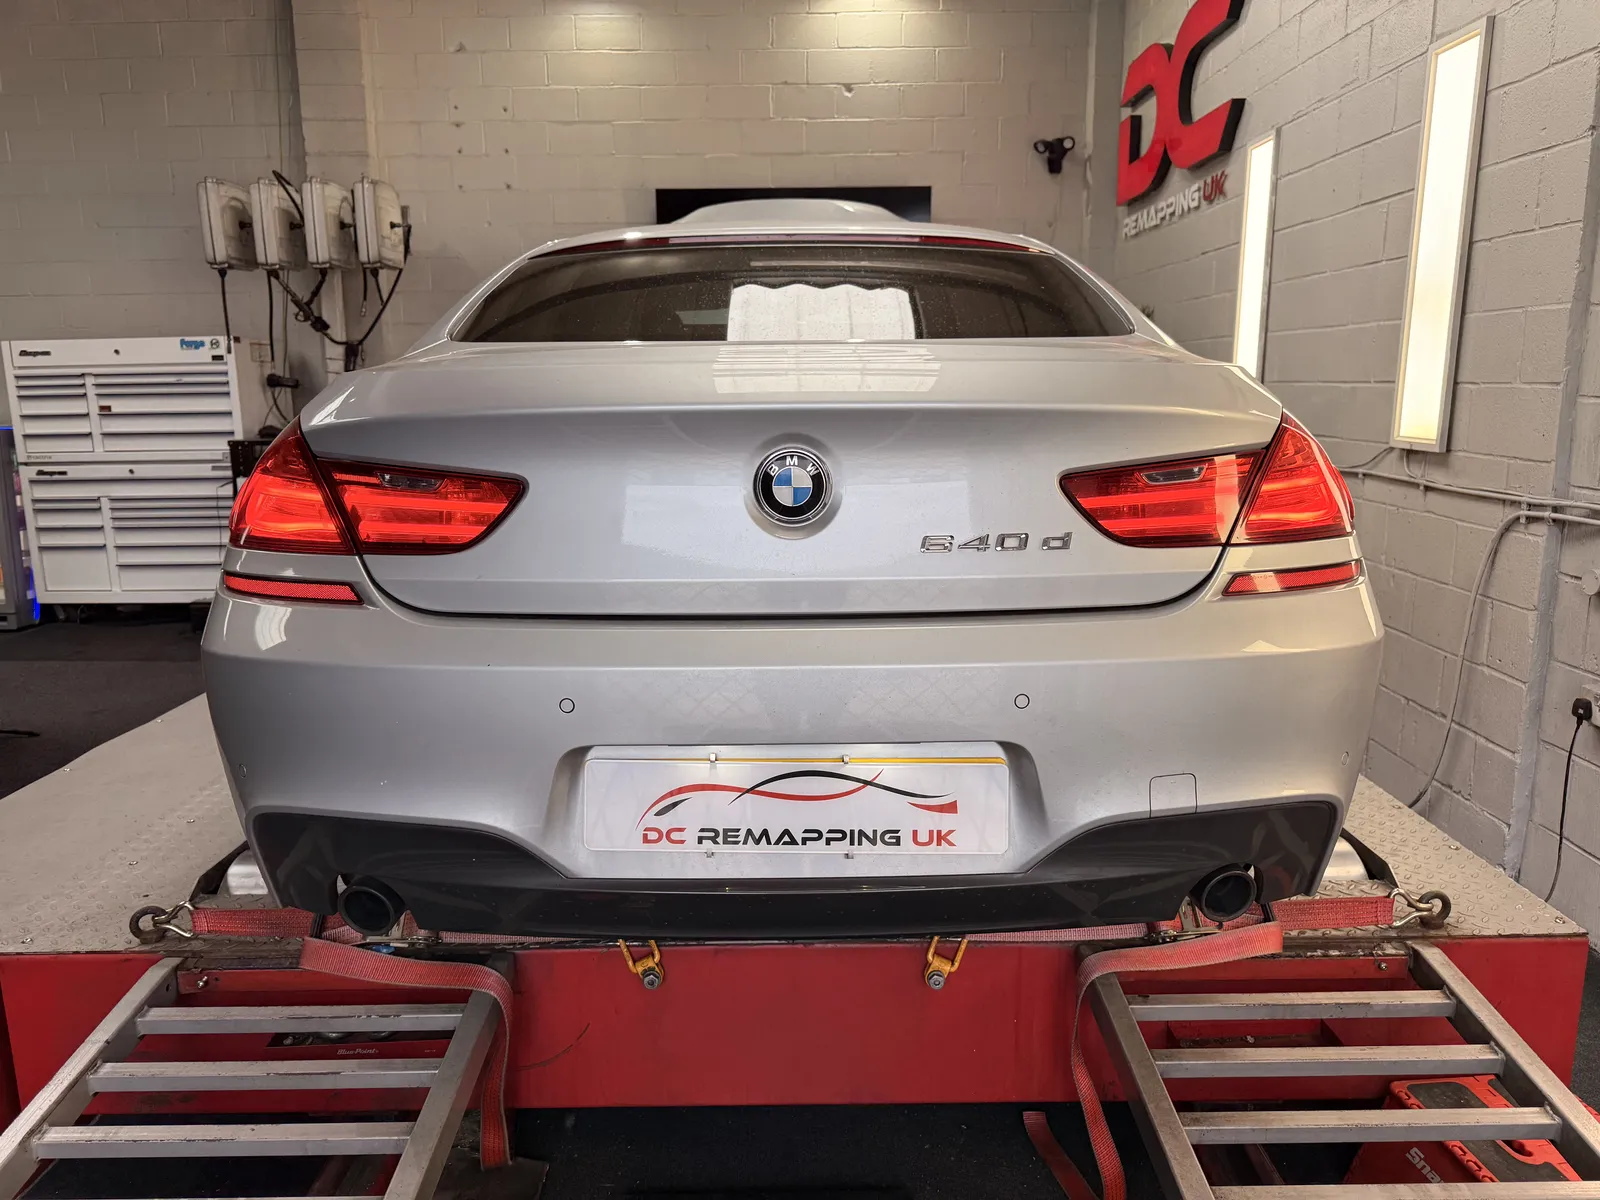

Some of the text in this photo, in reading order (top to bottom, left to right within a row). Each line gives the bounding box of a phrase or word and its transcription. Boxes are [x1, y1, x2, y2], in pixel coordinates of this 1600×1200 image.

[1116, 0, 1246, 206] DC
[1122, 169, 1228, 239] REMAPPING UK
[766, 455, 819, 477] BMW
[920, 531, 1074, 552] 640 d
[642, 827, 958, 847] DC REMAPPING UK
[1405, 1146, 1445, 1184] Sna
